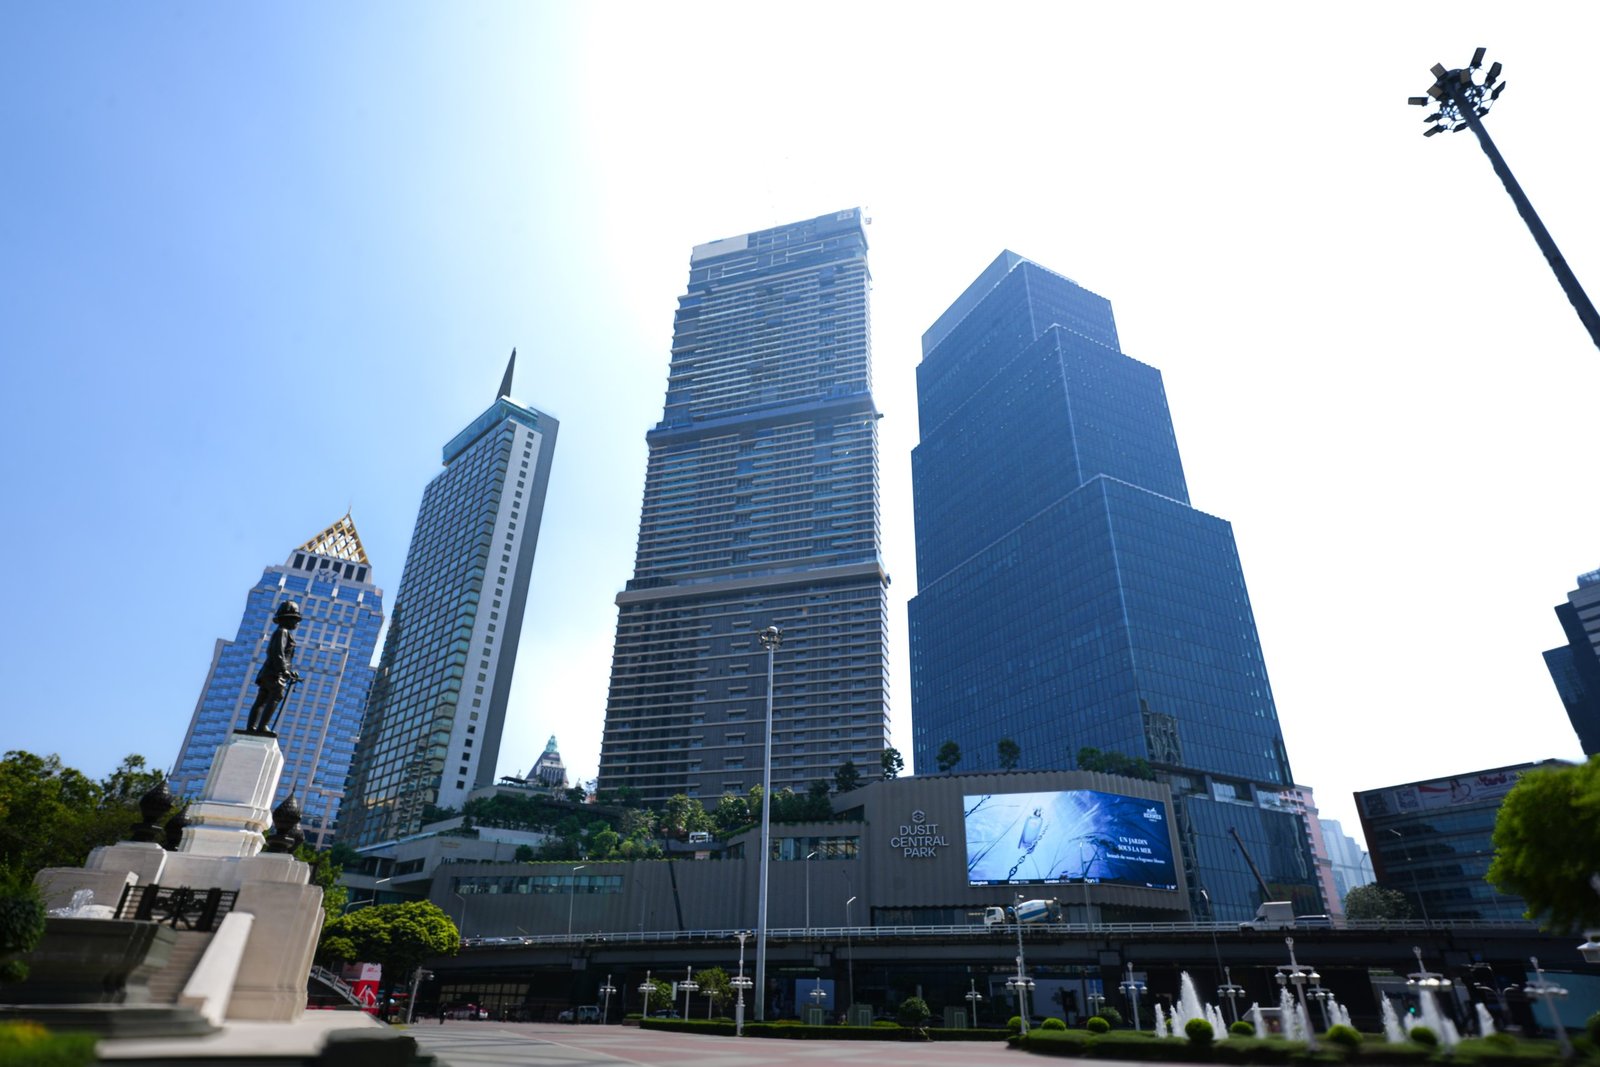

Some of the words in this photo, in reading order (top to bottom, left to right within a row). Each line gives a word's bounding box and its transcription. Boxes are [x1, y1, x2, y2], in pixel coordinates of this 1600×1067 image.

[899, 824, 939, 836] DUSIT
[890, 836, 950, 848] CENTRAL
[903, 847, 937, 858] PARK
